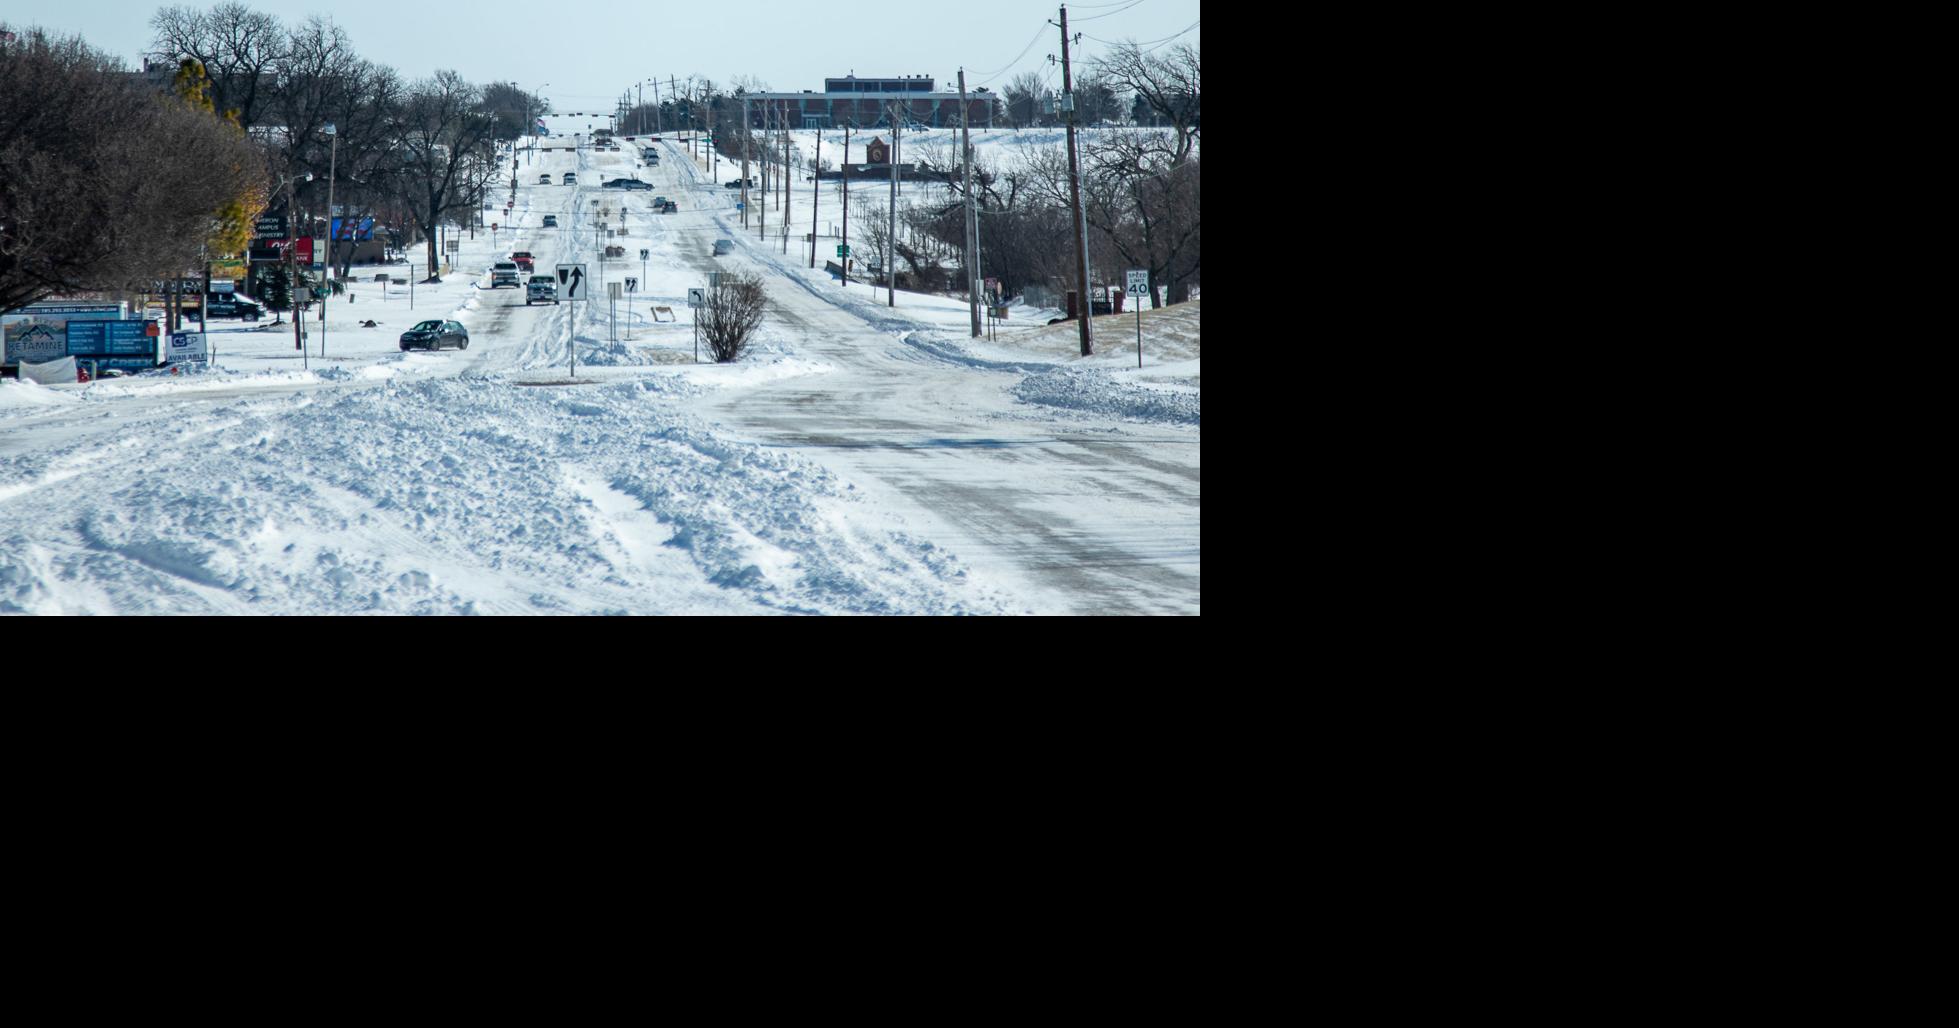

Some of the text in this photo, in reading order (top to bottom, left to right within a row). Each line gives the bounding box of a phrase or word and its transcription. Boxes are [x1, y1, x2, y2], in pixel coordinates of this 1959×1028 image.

[1128, 283, 1147, 293] 40
[8, 341, 63, 351] KETAMINE
[168, 353, 205, 361] AVAILABLE
